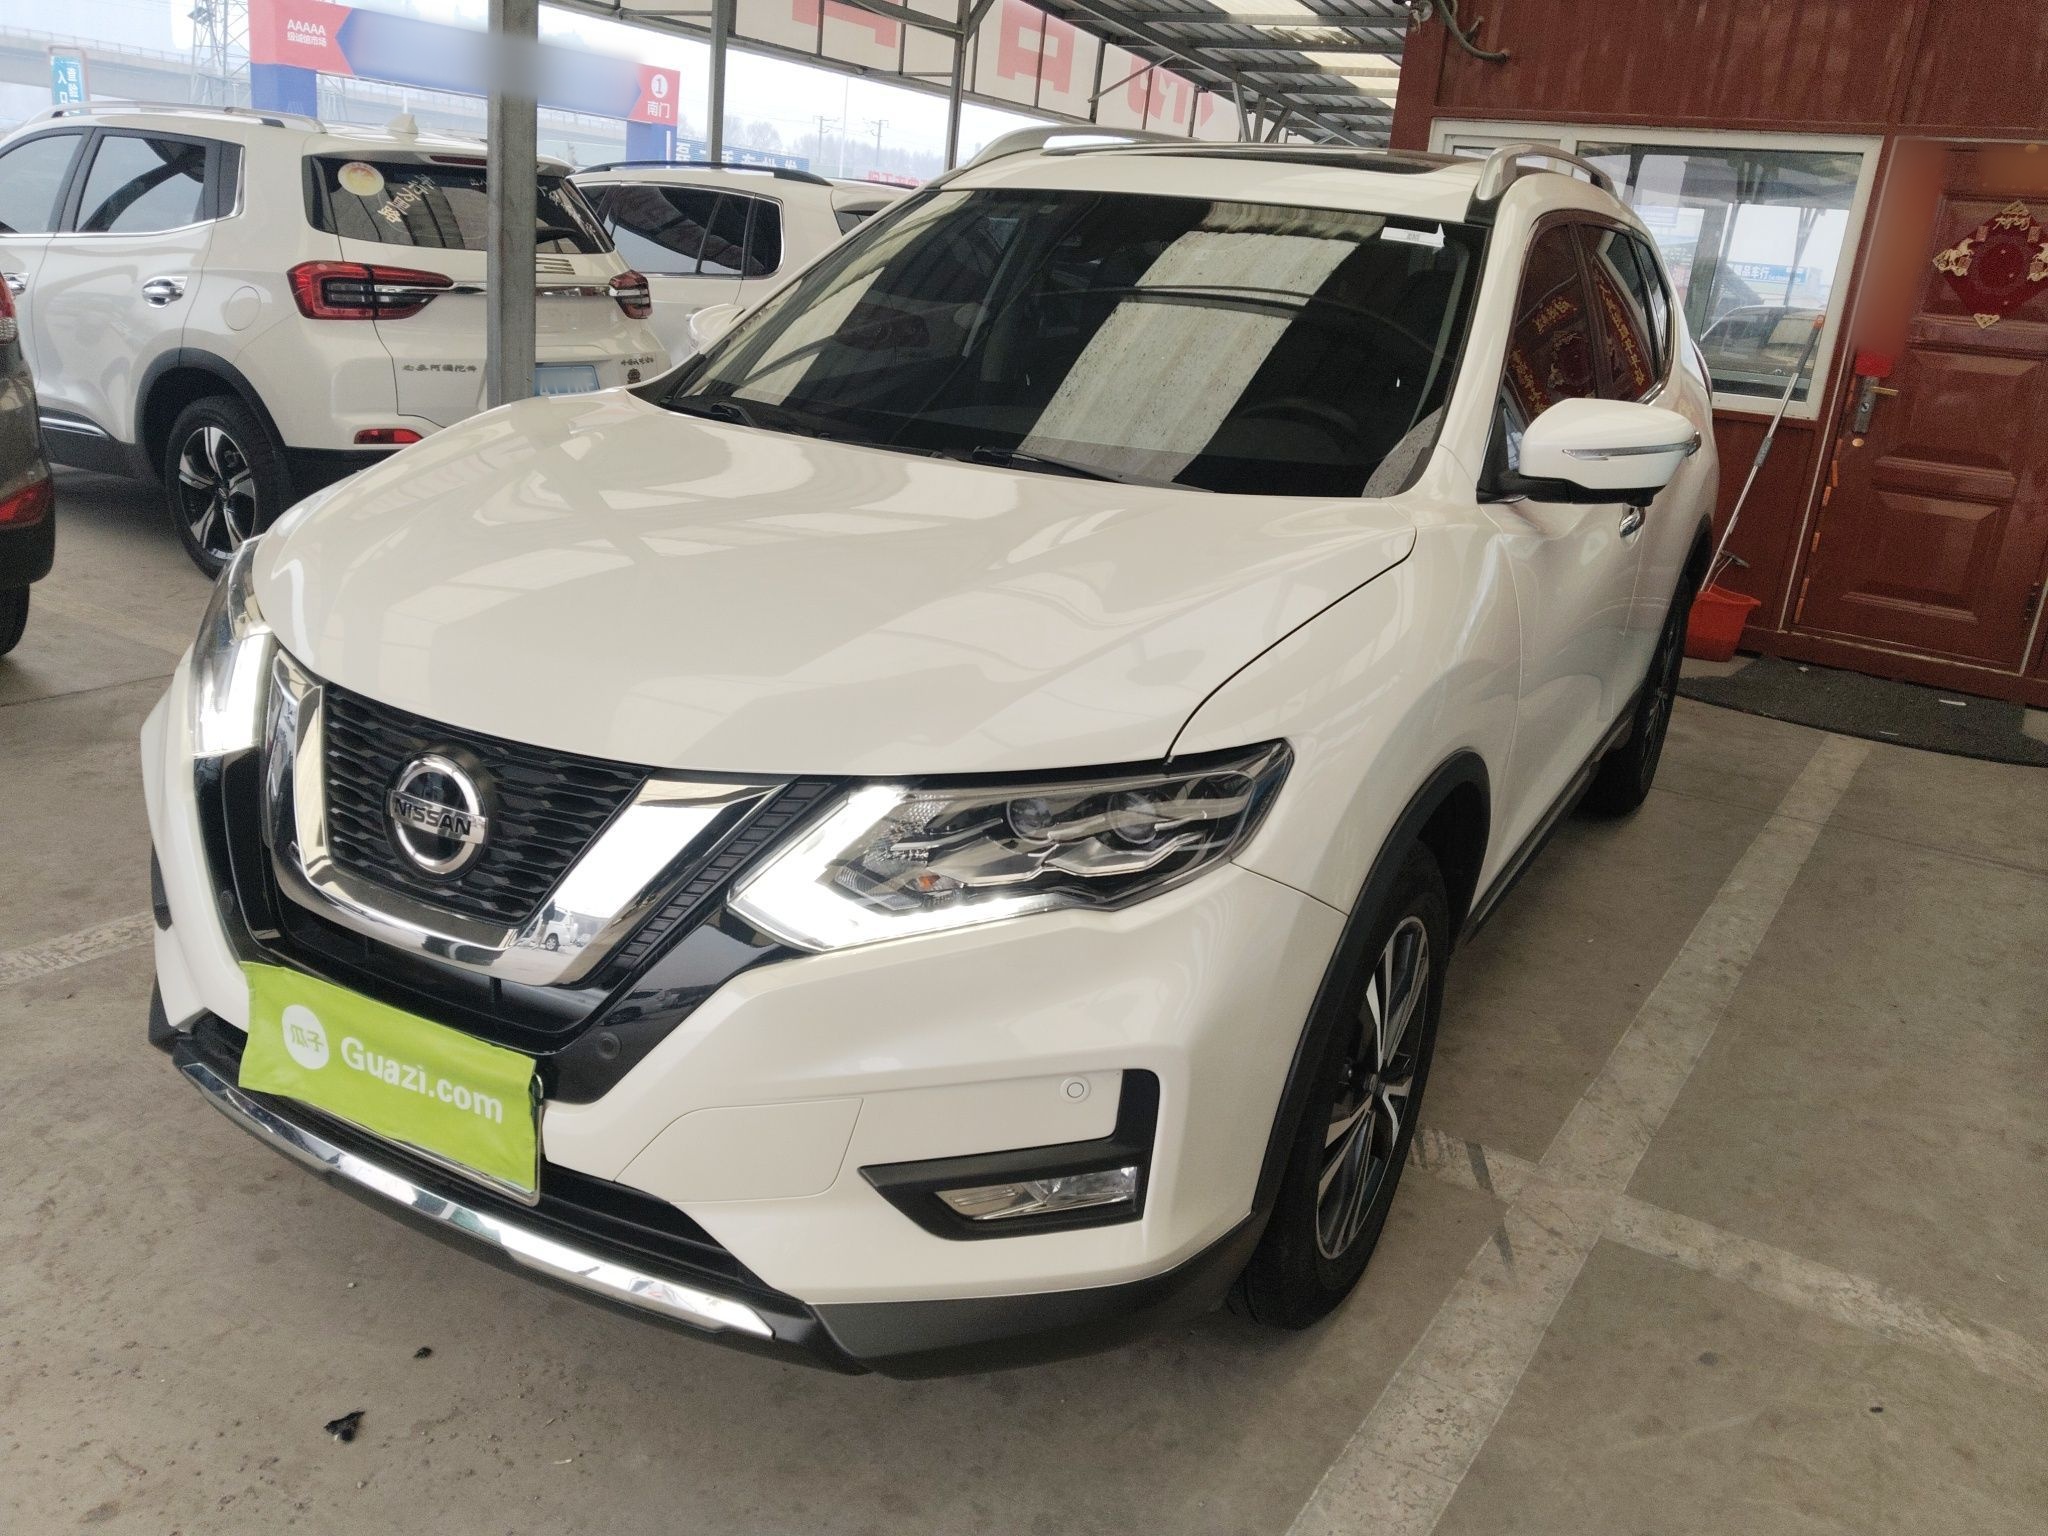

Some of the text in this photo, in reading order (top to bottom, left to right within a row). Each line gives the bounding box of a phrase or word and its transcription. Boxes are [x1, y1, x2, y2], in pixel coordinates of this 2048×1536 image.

[287, 19, 326, 36] AAAAA
[57, 70, 68, 104] 入口
[647, 100, 671, 119] 南门
[394, 797, 472, 837] NISSAN
[289, 1023, 325, 1053] 瓜子
[340, 1036, 503, 1125] Guazi.com
